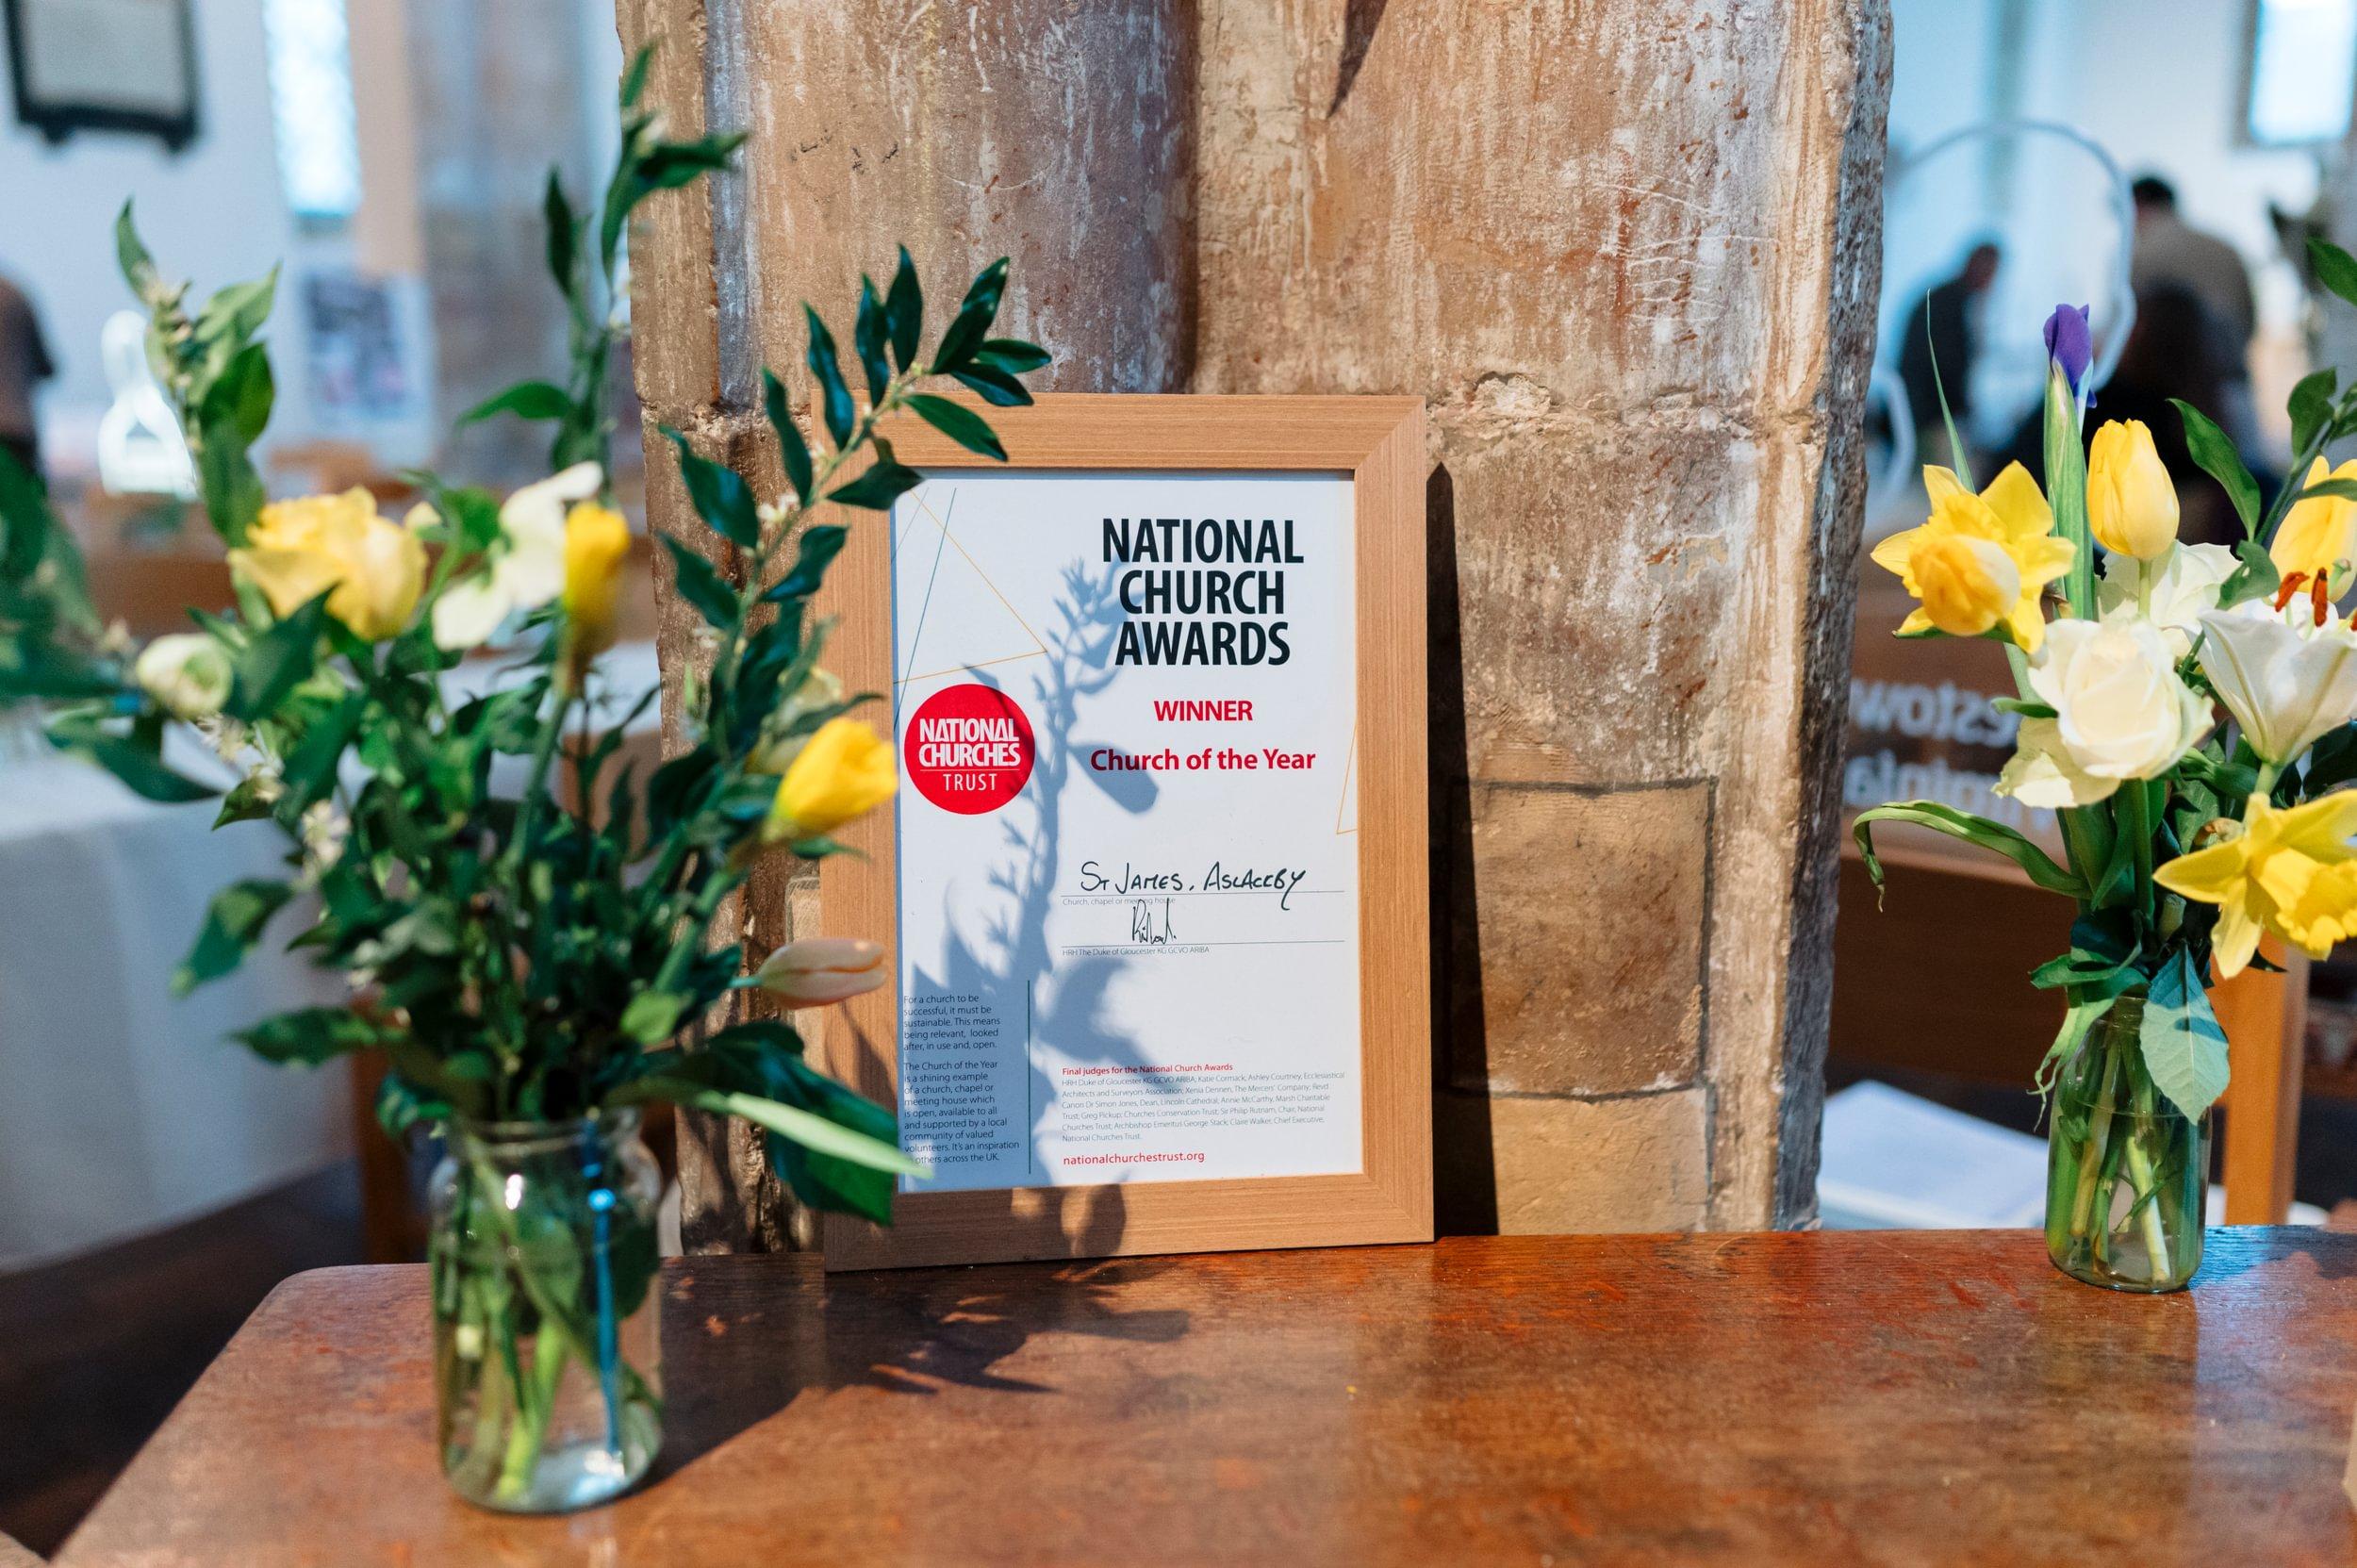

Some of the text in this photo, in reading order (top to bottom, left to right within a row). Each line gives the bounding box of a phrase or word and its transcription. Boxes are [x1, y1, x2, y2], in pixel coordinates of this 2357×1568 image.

[1102, 518, 1305, 565] NATIONAL
[1119, 569, 1285, 616] CHURCH
[1114, 620, 1292, 667] AWARDS
[1153, 700, 1254, 722] WINNER
[918, 718, 1020, 744] NATIONAL
[918, 741, 1022, 768] CHURCHES
[1090, 749, 1317, 772] Church of the Year
[943, 773, 998, 792] TRUST
[1063, 898, 1090, 906] Church,
[1091, 897, 1114, 906] chapel
[1093, 948, 1111, 956] Duke
[1120, 947, 1156, 955] Gloucester
[1189, 946, 1210, 954] ARIBA
[926, 995, 955, 1003] church
[968, 994, 980, 1002] be
[904, 1006, 948, 1016] successful,
[981, 1005, 992, 1014] be
[904, 1018, 952, 1028] sustainable.
[955, 1017, 971, 1026] This
[904, 1029, 998, 1041] being relevant, looked
[904, 1043, 925, 1051] after,
[953, 1041, 970, 1049] and,
[904, 1060, 998, 1071] The Church of the Year
[1063, 1067, 1081, 1076] Final
[1082, 1066, 1110, 1077] judges
[1112, 1065, 1123, 1074] for
[1125, 1065, 1138, 1074] the
[1139, 1065, 1173, 1073] National
[1175, 1064, 1203, 1072] Church
[919, 1073, 950, 1083] shining
[952, 1072, 988, 1081] example
[904, 1086, 914, 1095] of
[922, 1085, 953, 1095] church,
[955, 1084, 982, 1094] chapel
[904, 1095, 995, 1107] meeting house which
[905, 1110, 911, 1118] is
[913, 1110, 937, 1119] open,
[939, 1107, 975, 1116] available
[978, 1107, 987, 1115] to
[904, 1121, 921, 1130] and
[923, 1119, 966, 1130] supported
[968, 1118, 980, 1129] by
[988, 1117, 1008, 1127] local
[904, 1130, 994, 1142] community of valued
[904, 1142, 949, 1153] volunteers.
[952, 1142, 964, 1151] It's
[978, 1141, 1020, 1149] inspiration
[915, 1153, 942, 1164] others
[944, 1154, 968, 1163] across
[986, 1152, 999, 1161] UK.
[1063, 1151, 1205, 1165] nationalchurchestrust.org
